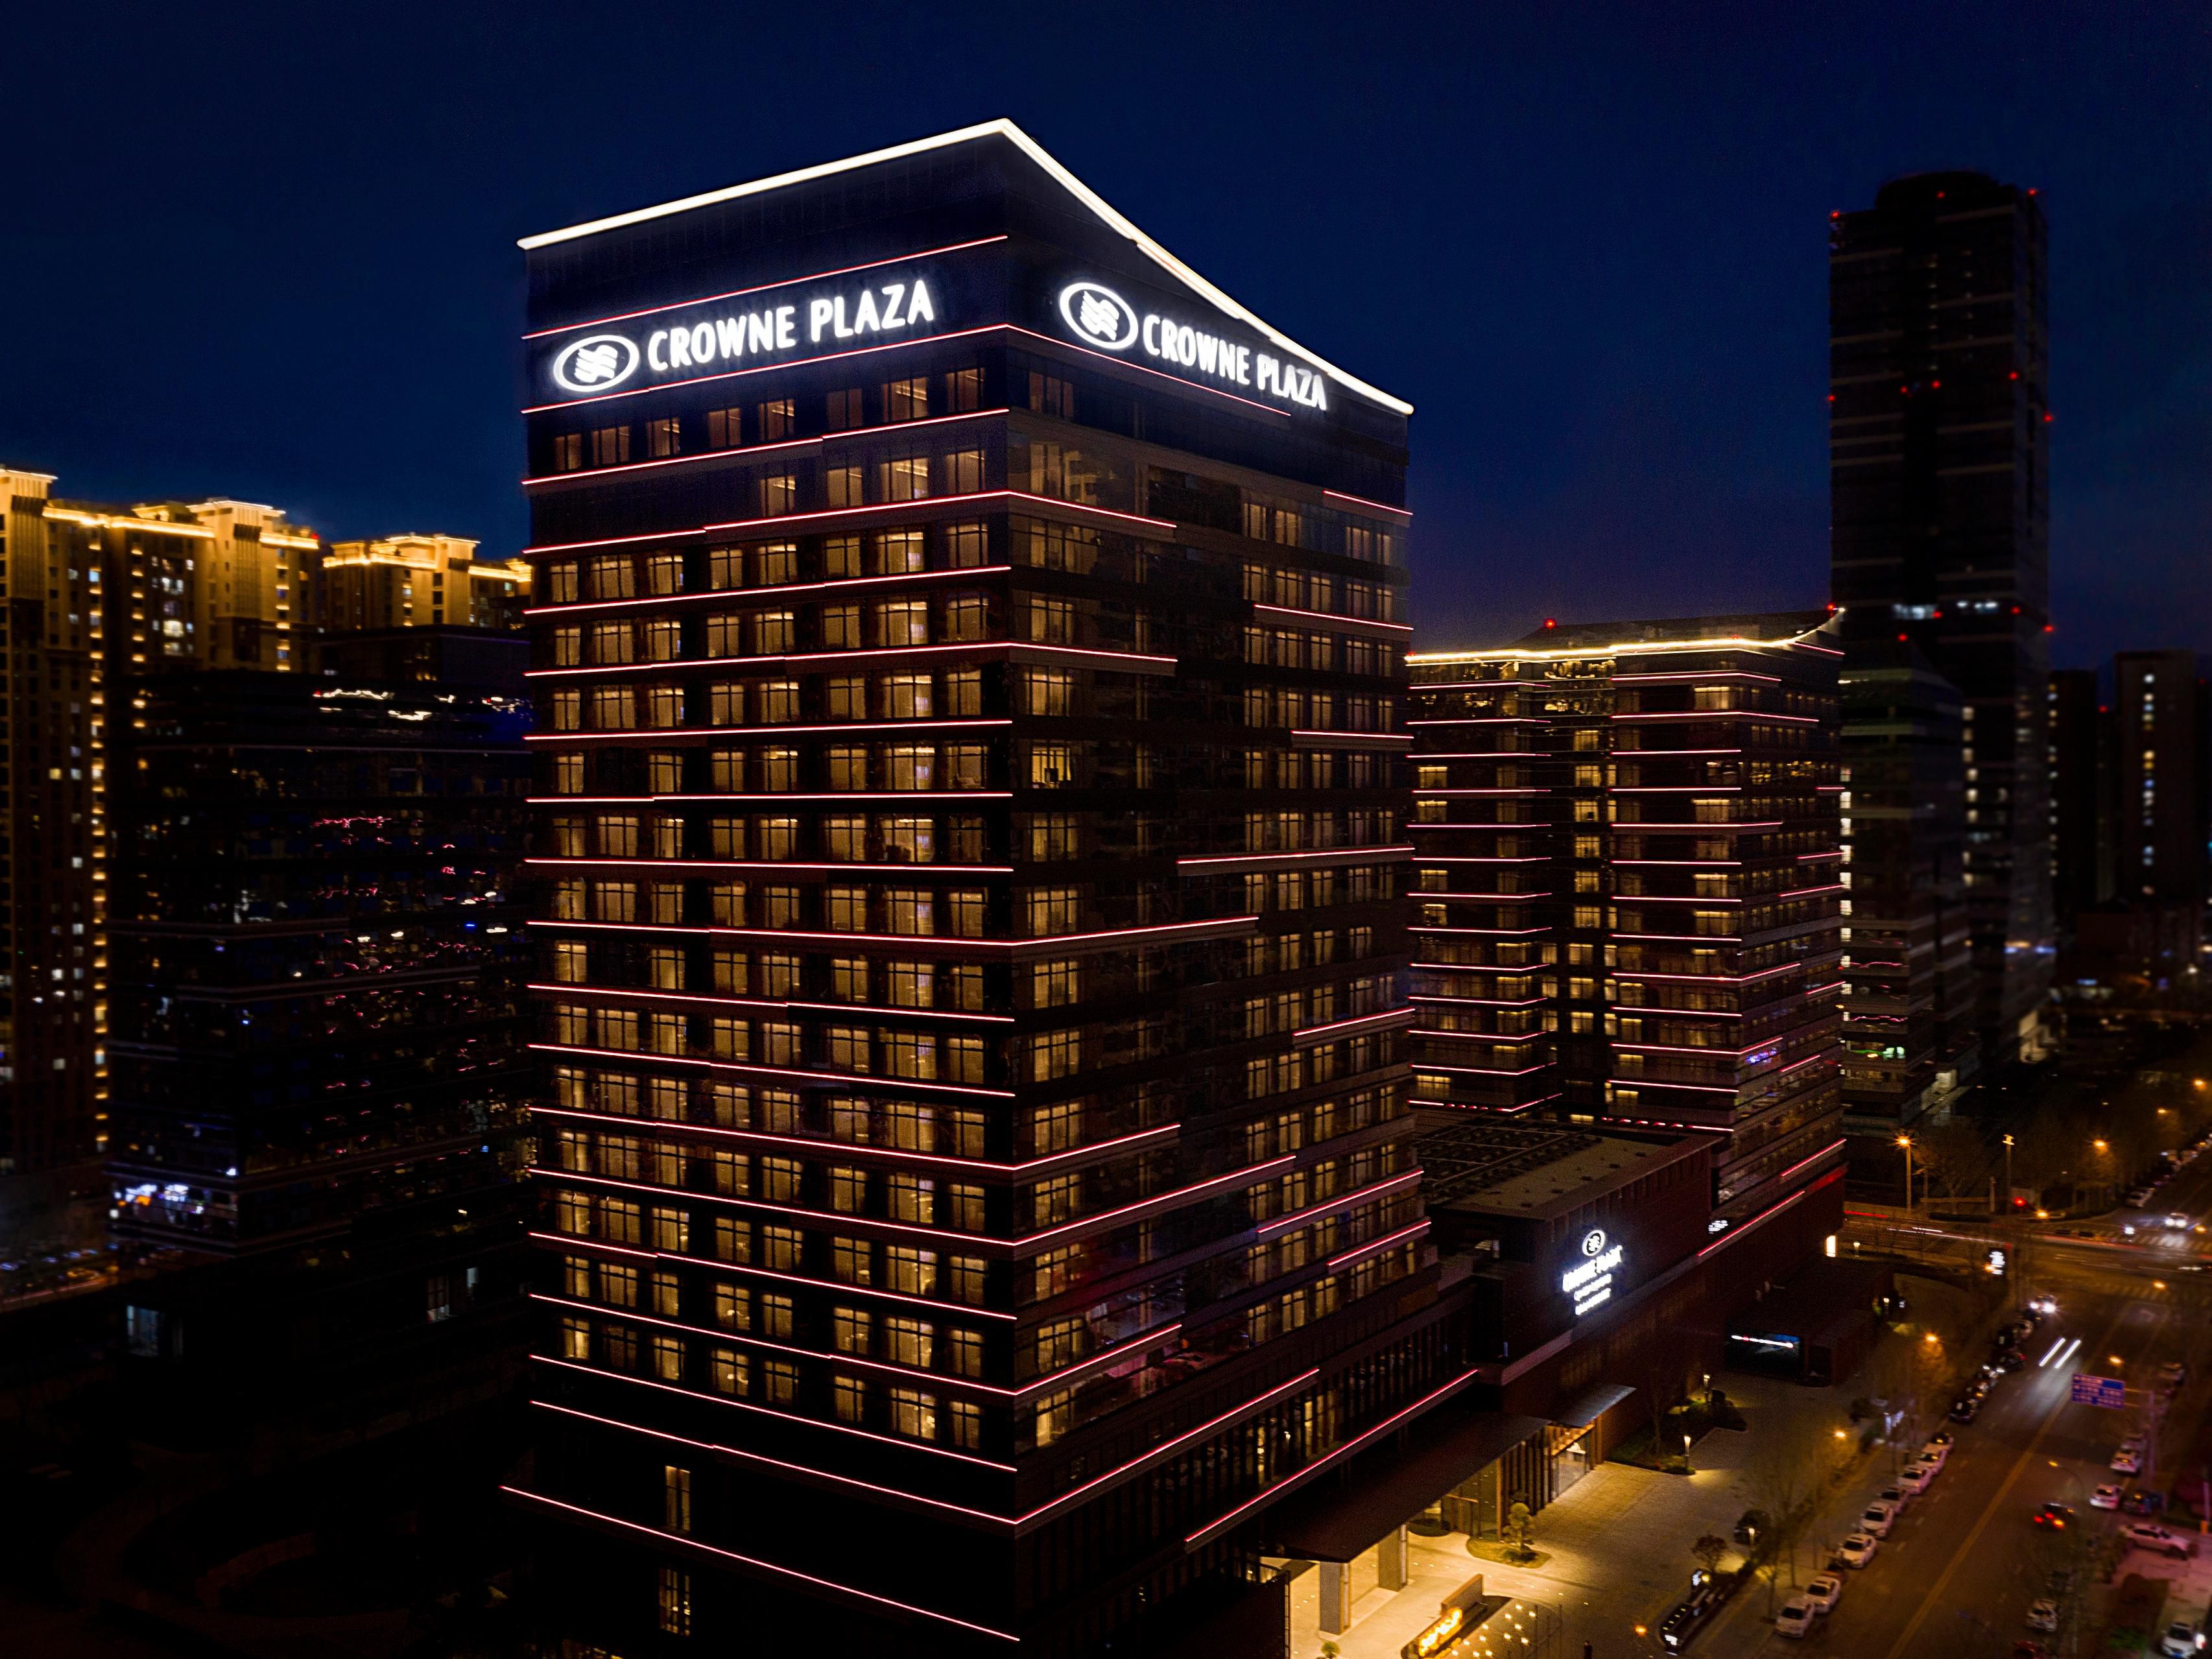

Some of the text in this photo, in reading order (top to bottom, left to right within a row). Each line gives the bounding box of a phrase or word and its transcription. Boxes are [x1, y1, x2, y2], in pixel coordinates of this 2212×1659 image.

[647, 279, 934, 372] CROWNE PLAZA
[1142, 314, 1327, 411] CROWNE PLAZA
